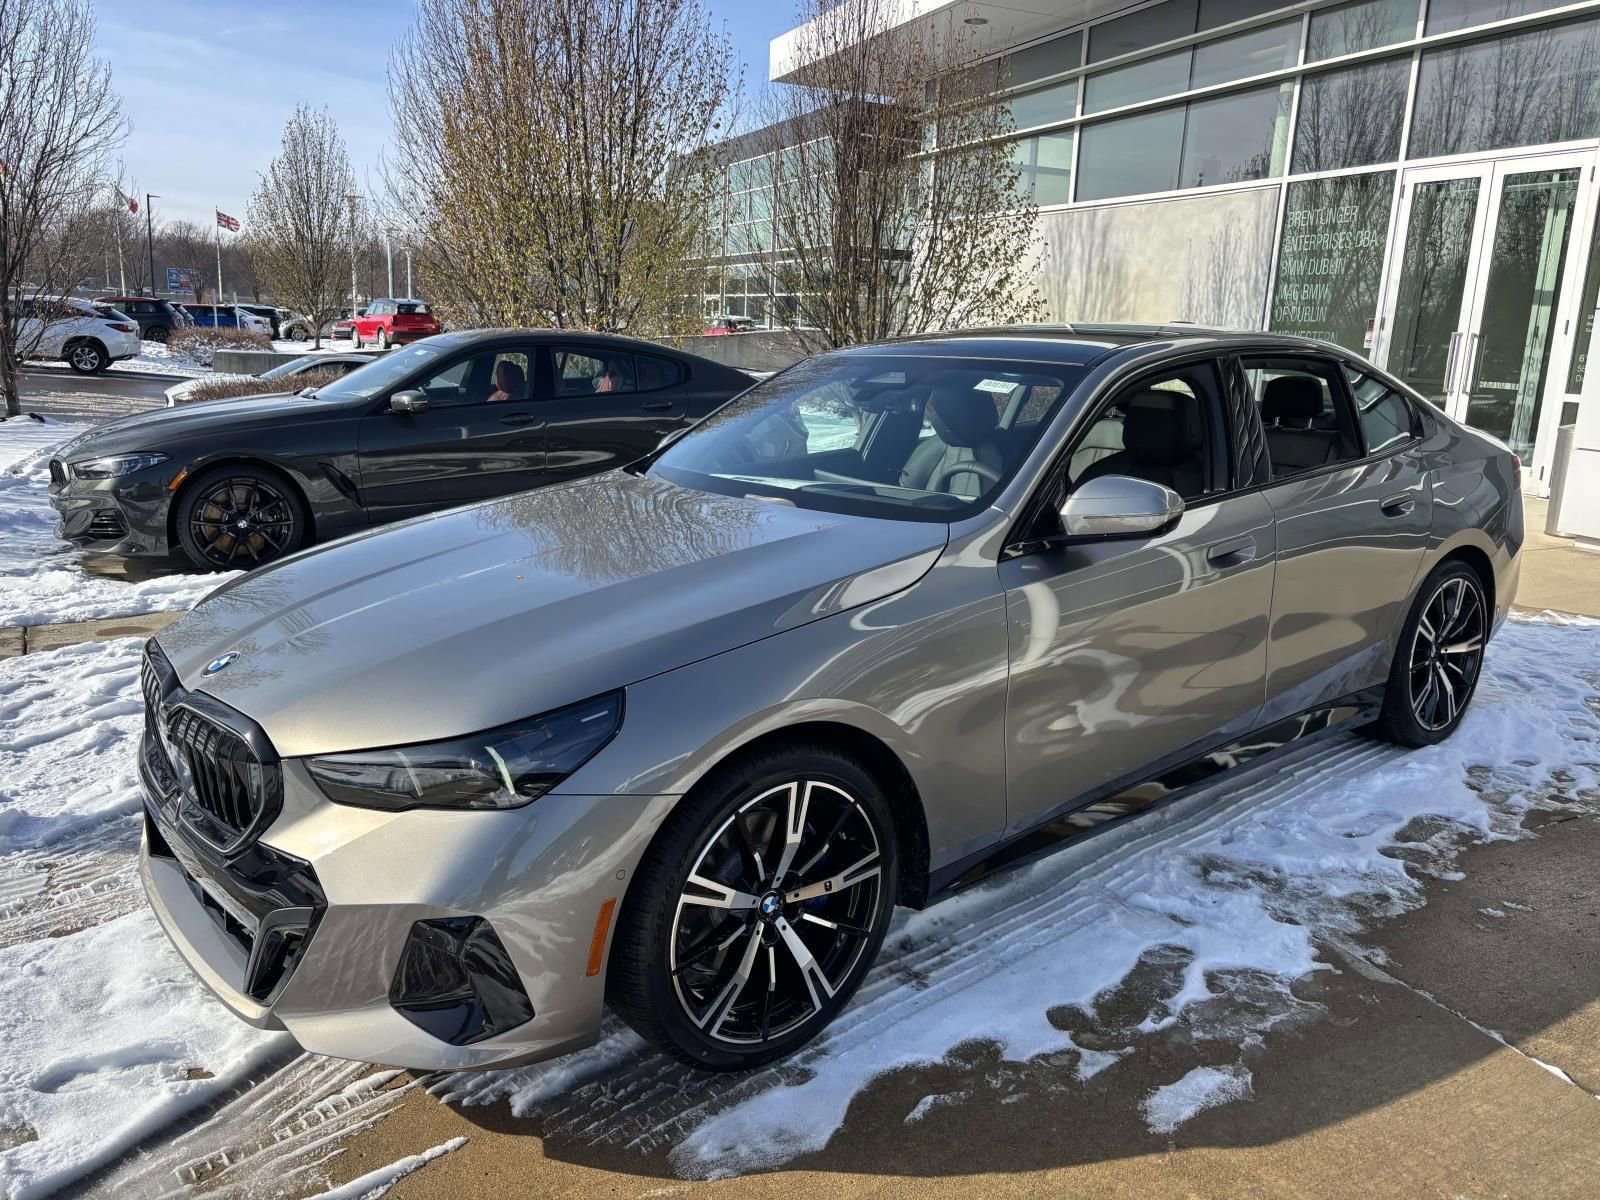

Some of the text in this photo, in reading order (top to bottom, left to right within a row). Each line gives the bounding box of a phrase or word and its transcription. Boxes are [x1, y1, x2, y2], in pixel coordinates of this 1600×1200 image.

[1288, 206, 1359, 227] BRENTLINGER
[1285, 230, 1379, 252] ENTERPRISES DBA
[1280, 258, 1347, 276] BMW DUBLIN
[1279, 283, 1329, 300] MAG BMW
[1290, 306, 1328, 322] DUBLIN
